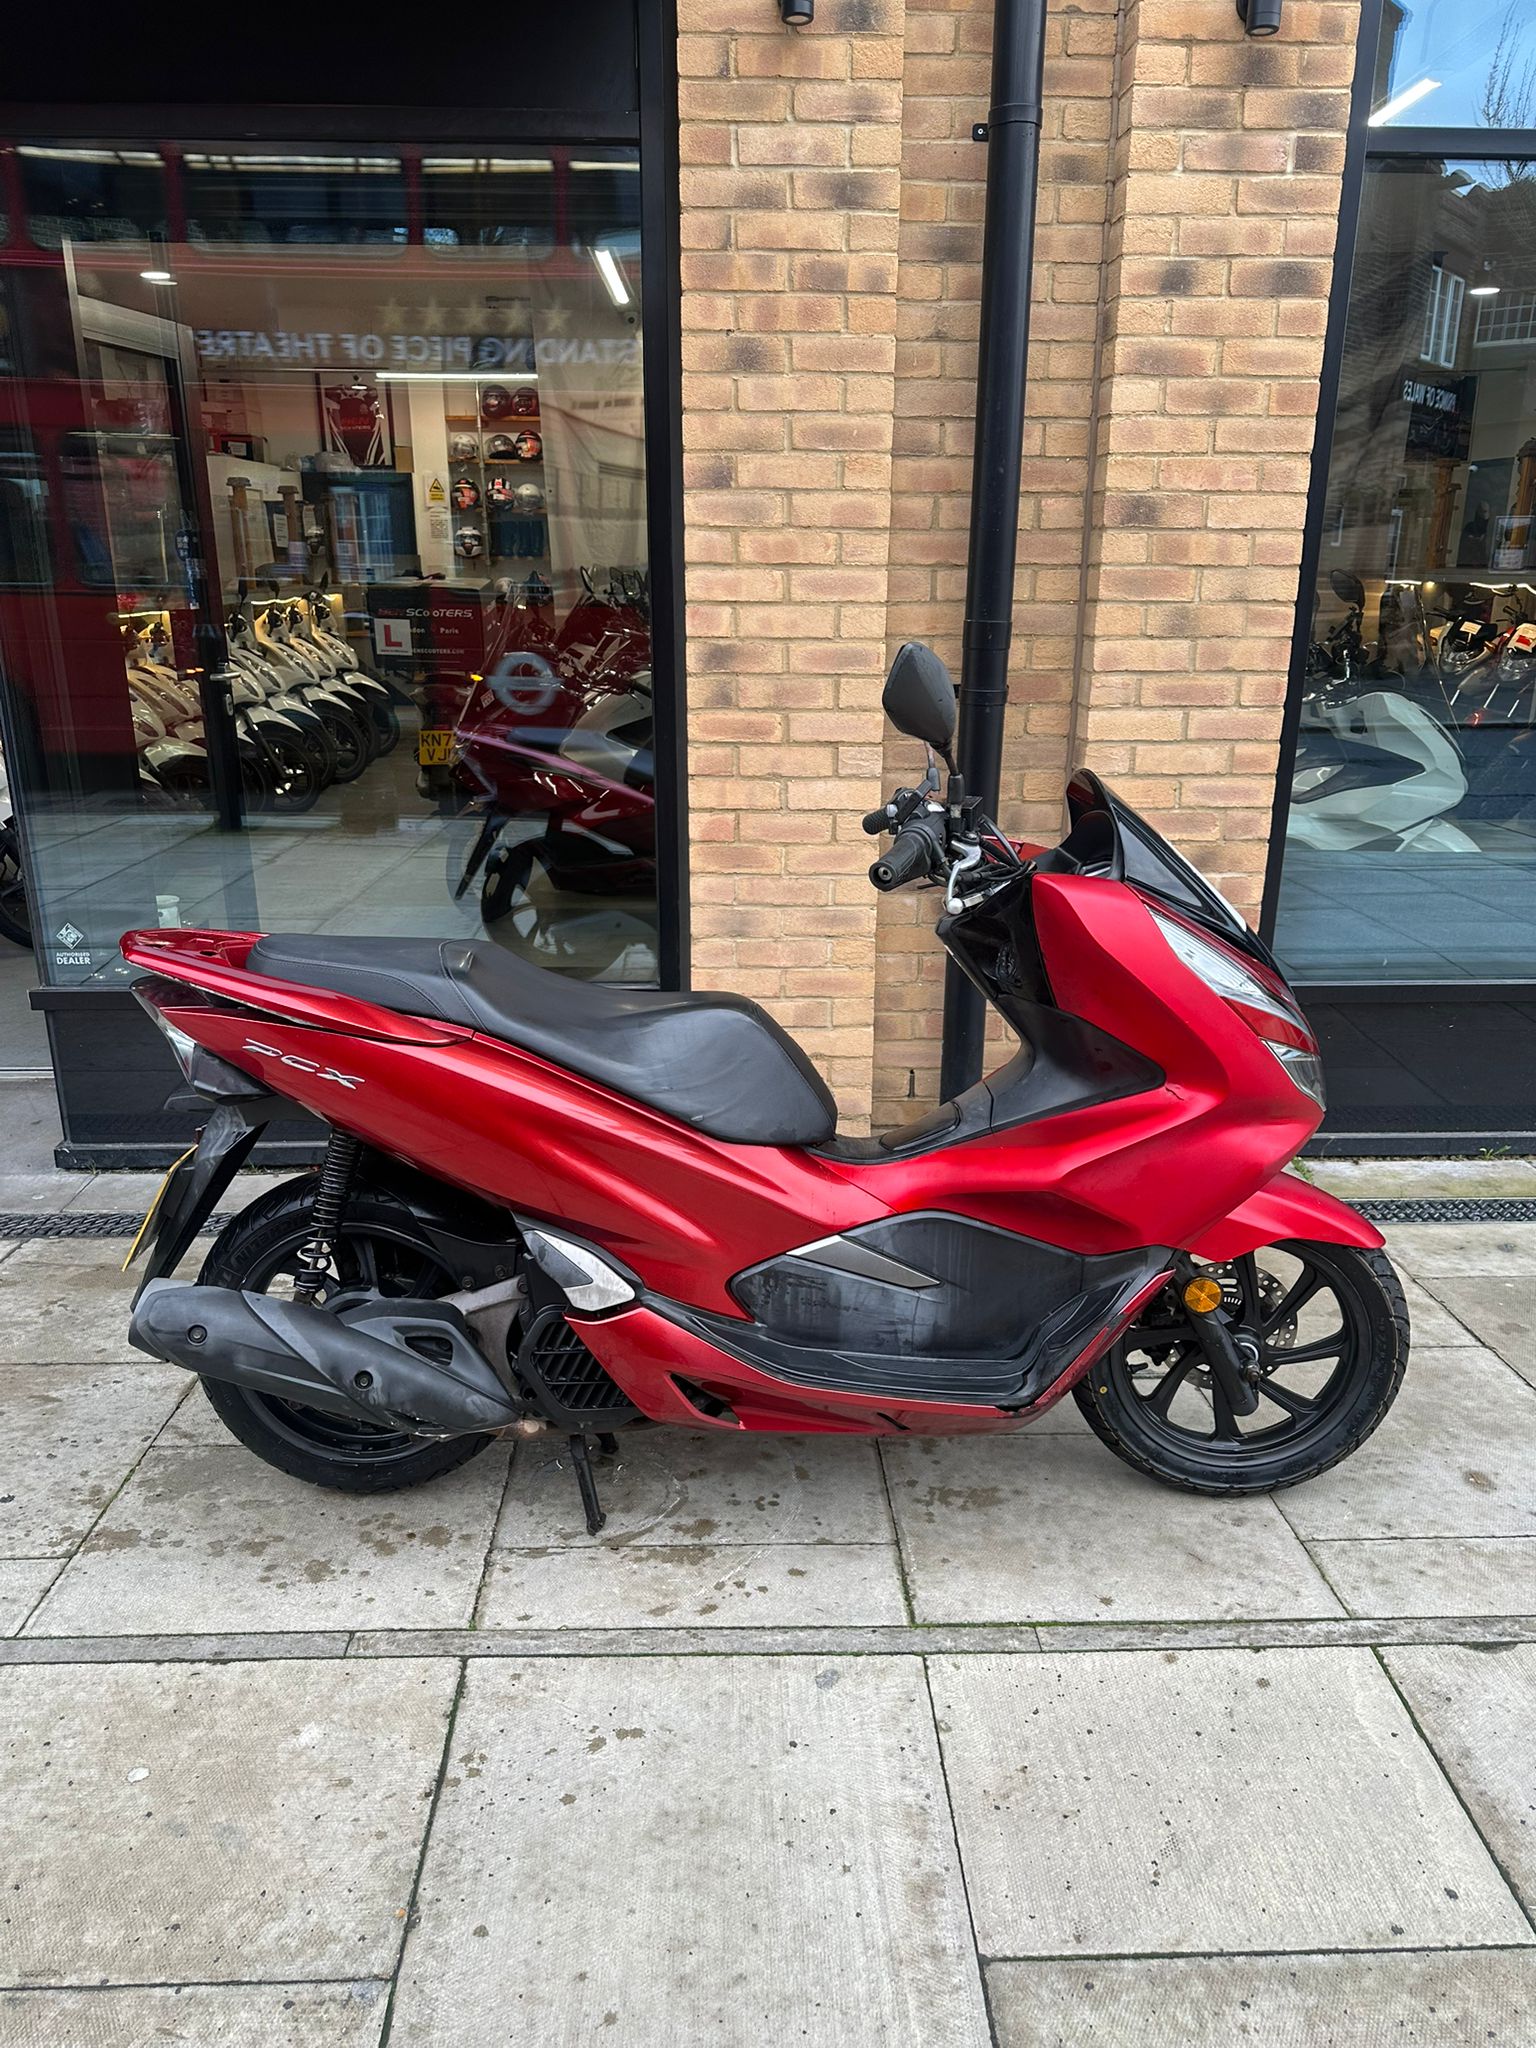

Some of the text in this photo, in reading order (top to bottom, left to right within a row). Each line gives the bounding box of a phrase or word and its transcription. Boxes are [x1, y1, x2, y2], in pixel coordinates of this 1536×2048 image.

[384, 624, 403, 648] L
[421, 733, 454, 748] KN7
[56, 957, 91, 965] DEALER
[242, 1038, 365, 1090] PCX
